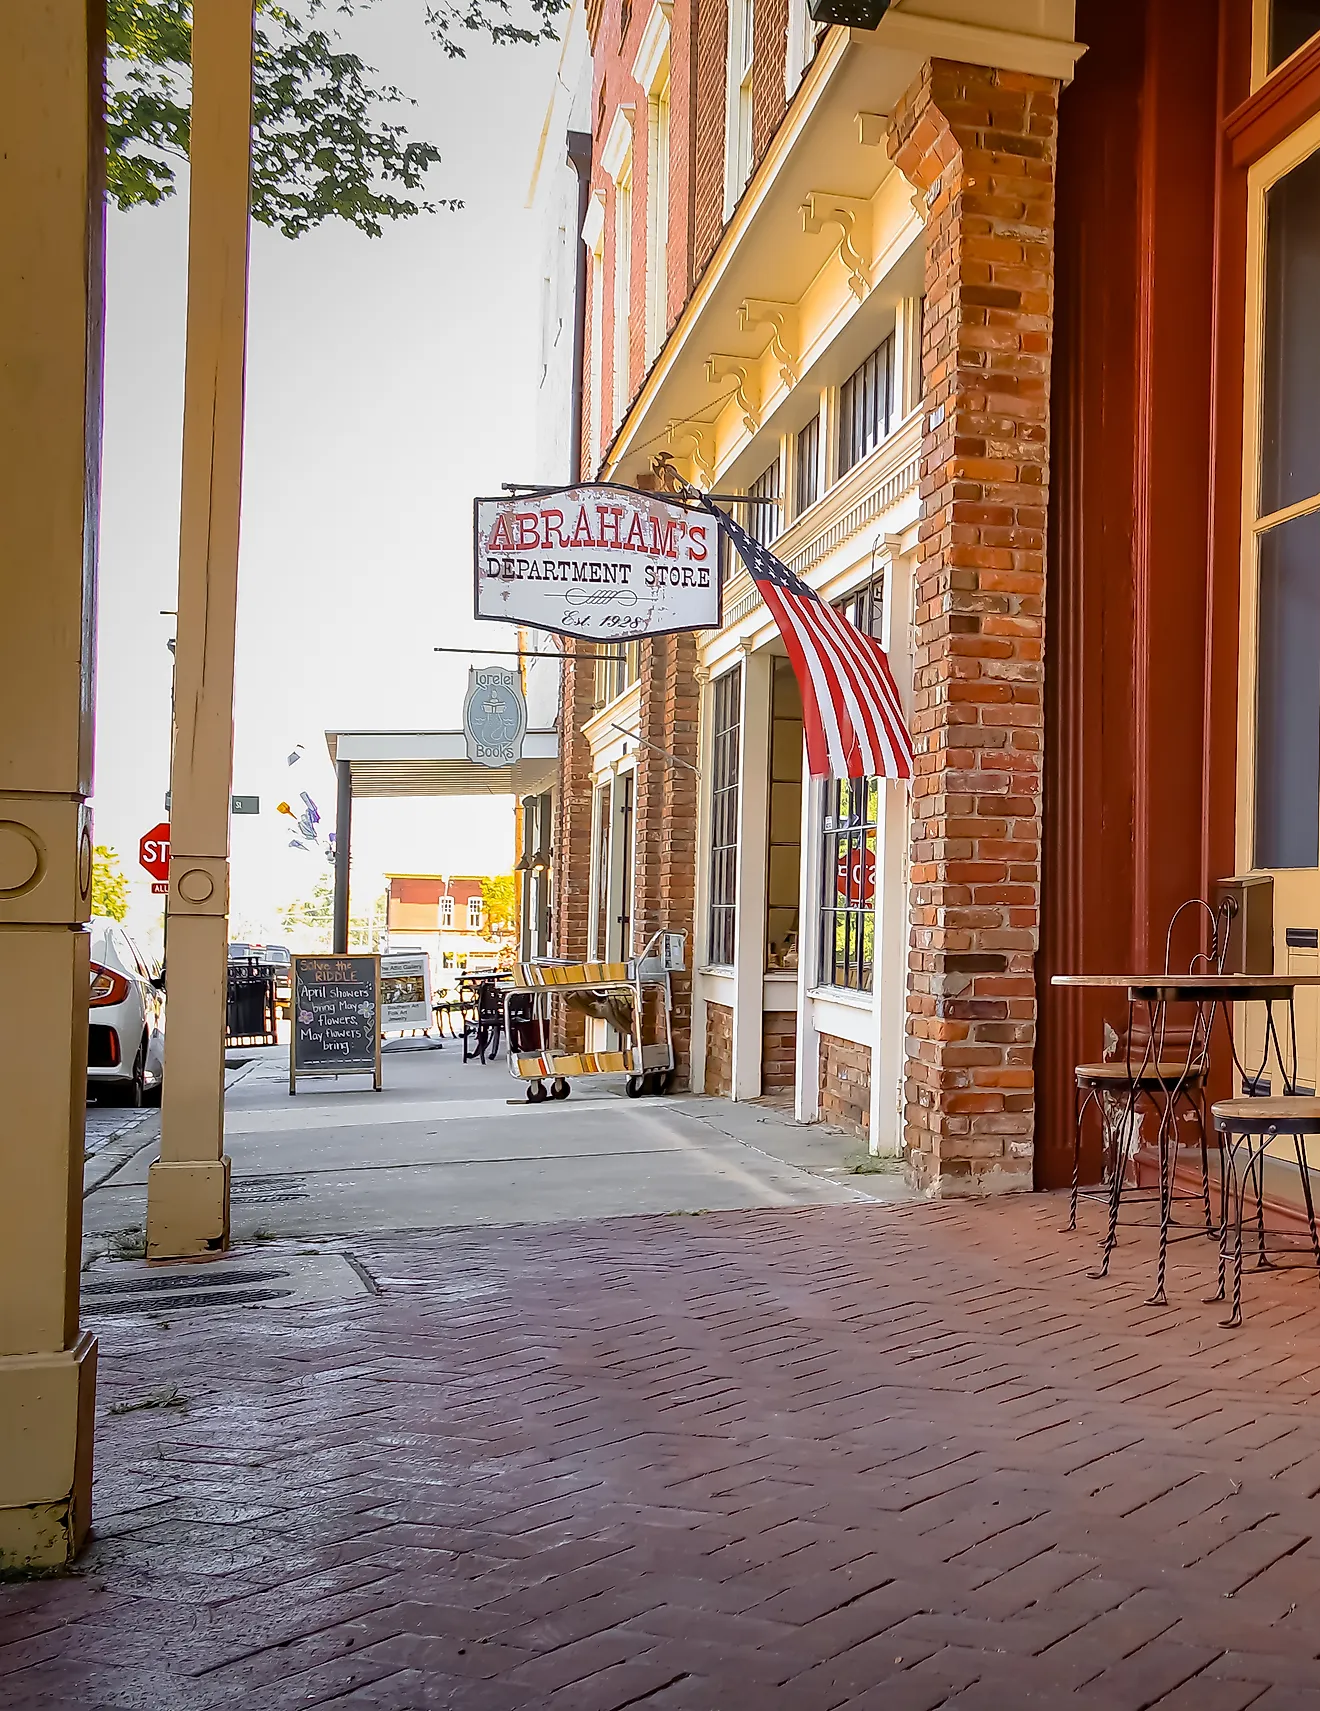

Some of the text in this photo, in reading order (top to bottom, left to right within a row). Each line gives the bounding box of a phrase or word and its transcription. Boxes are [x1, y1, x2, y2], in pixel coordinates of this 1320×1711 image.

[488, 505, 708, 561] ABRAHAM'S
[486, 557, 710, 588] DEPARTMENT STORE
[561, 610, 643, 630] Est. 1928
[475, 671, 514, 690] Lorelei
[476, 743, 514, 761] Books
[142, 840, 170, 863] ST
[300, 960, 352, 971] Solve the
[315, 970, 358, 982] RIDDLE
[301, 985, 369, 1001] April showers
[312, 1000, 357, 1015] bring May
[300, 1027, 361, 1042] May flowers
